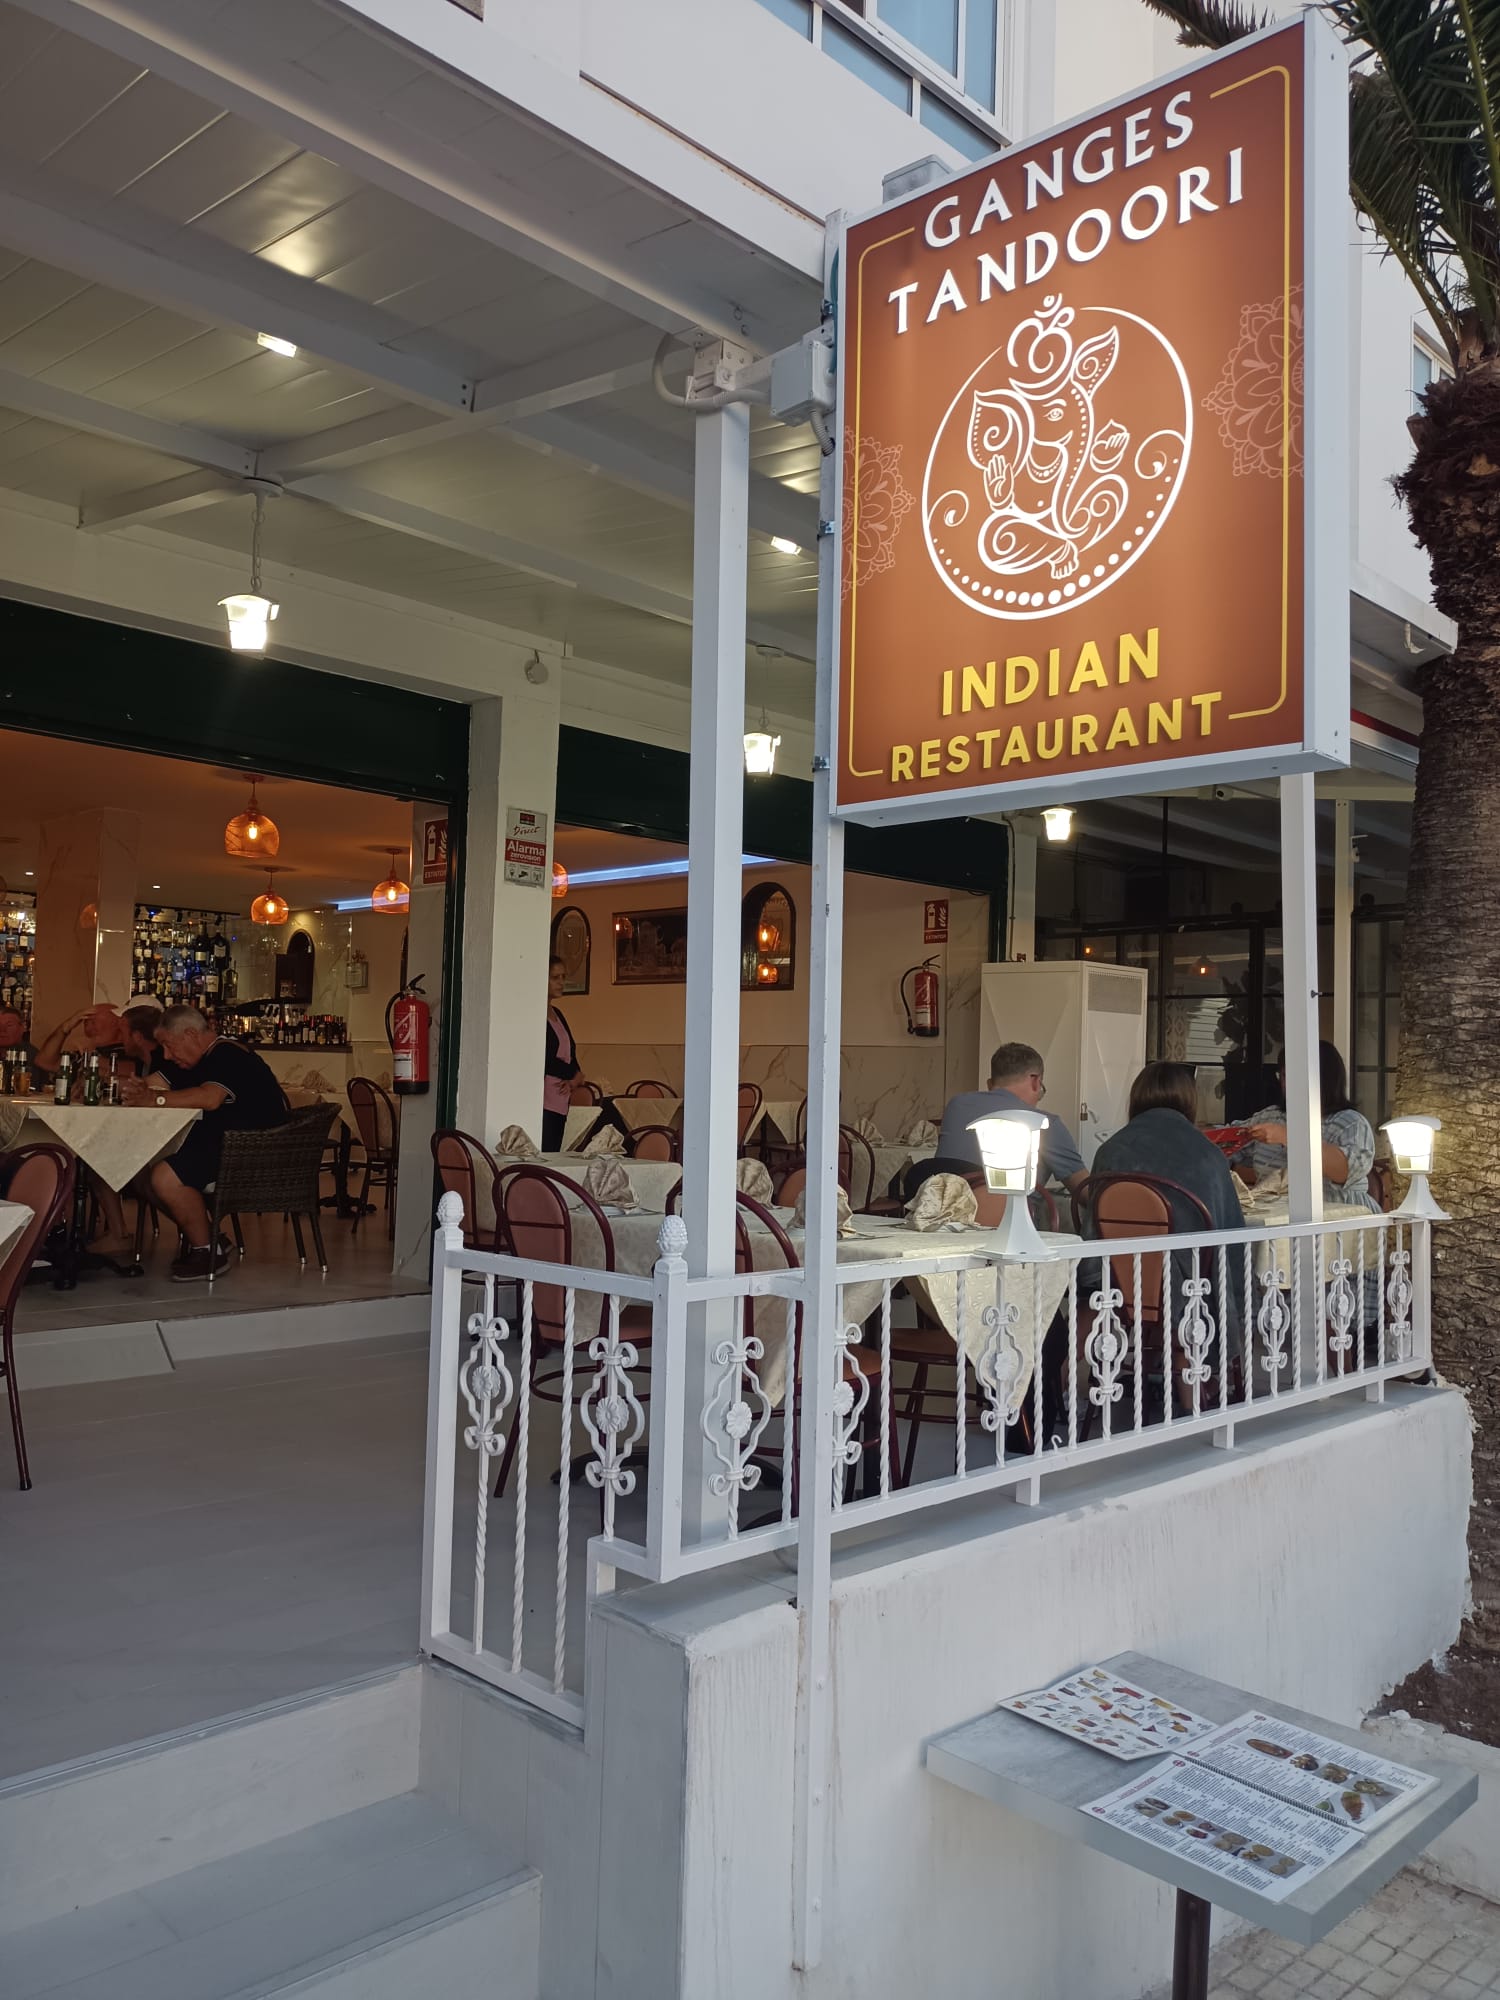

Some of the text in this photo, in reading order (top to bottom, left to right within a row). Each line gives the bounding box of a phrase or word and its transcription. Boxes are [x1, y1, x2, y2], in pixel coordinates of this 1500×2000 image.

[924, 91, 1195, 250] GANGES
[888, 147, 1245, 335] TANDOORI
[941, 627, 1159, 717] INDIAN
[890, 691, 1222, 784] RESTAURANT
[507, 840, 545, 857] Alarma
